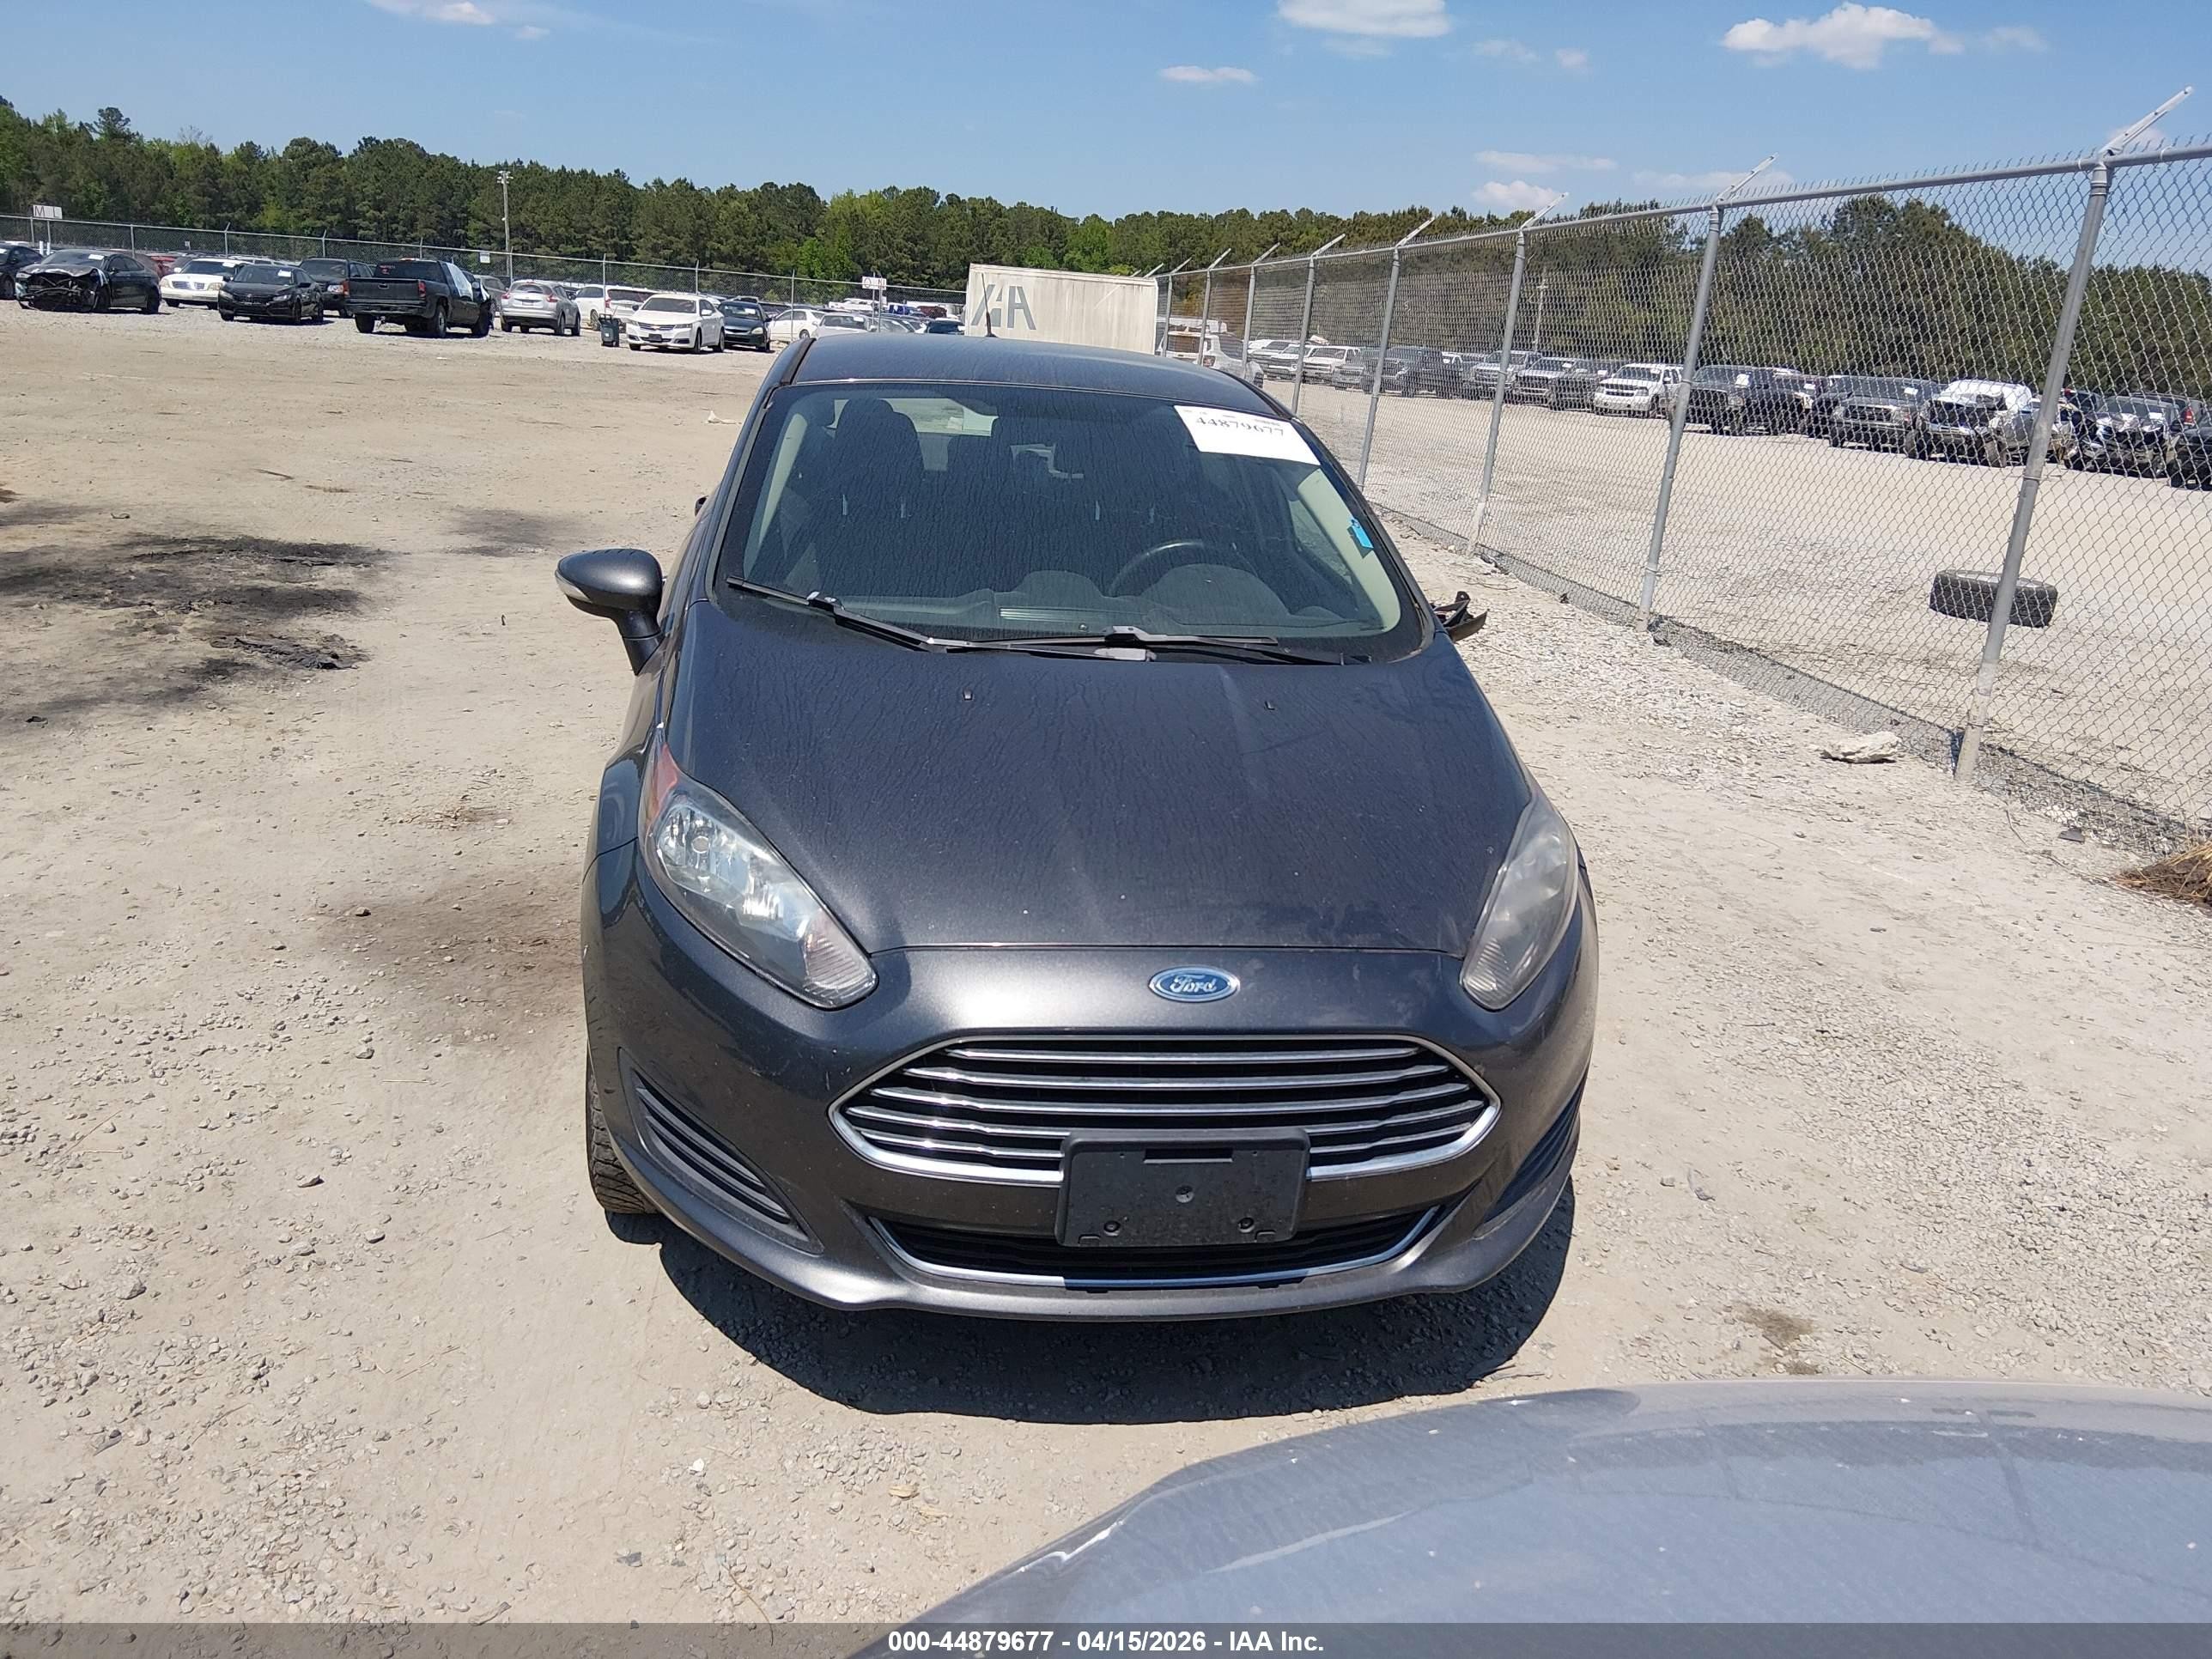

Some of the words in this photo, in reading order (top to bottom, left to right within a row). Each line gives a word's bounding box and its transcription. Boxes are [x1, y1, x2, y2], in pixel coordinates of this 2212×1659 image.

[35, 206, 46, 217] M
[1195, 416, 1285, 436] 44879677
[1169, 973, 1218, 994] Ford
